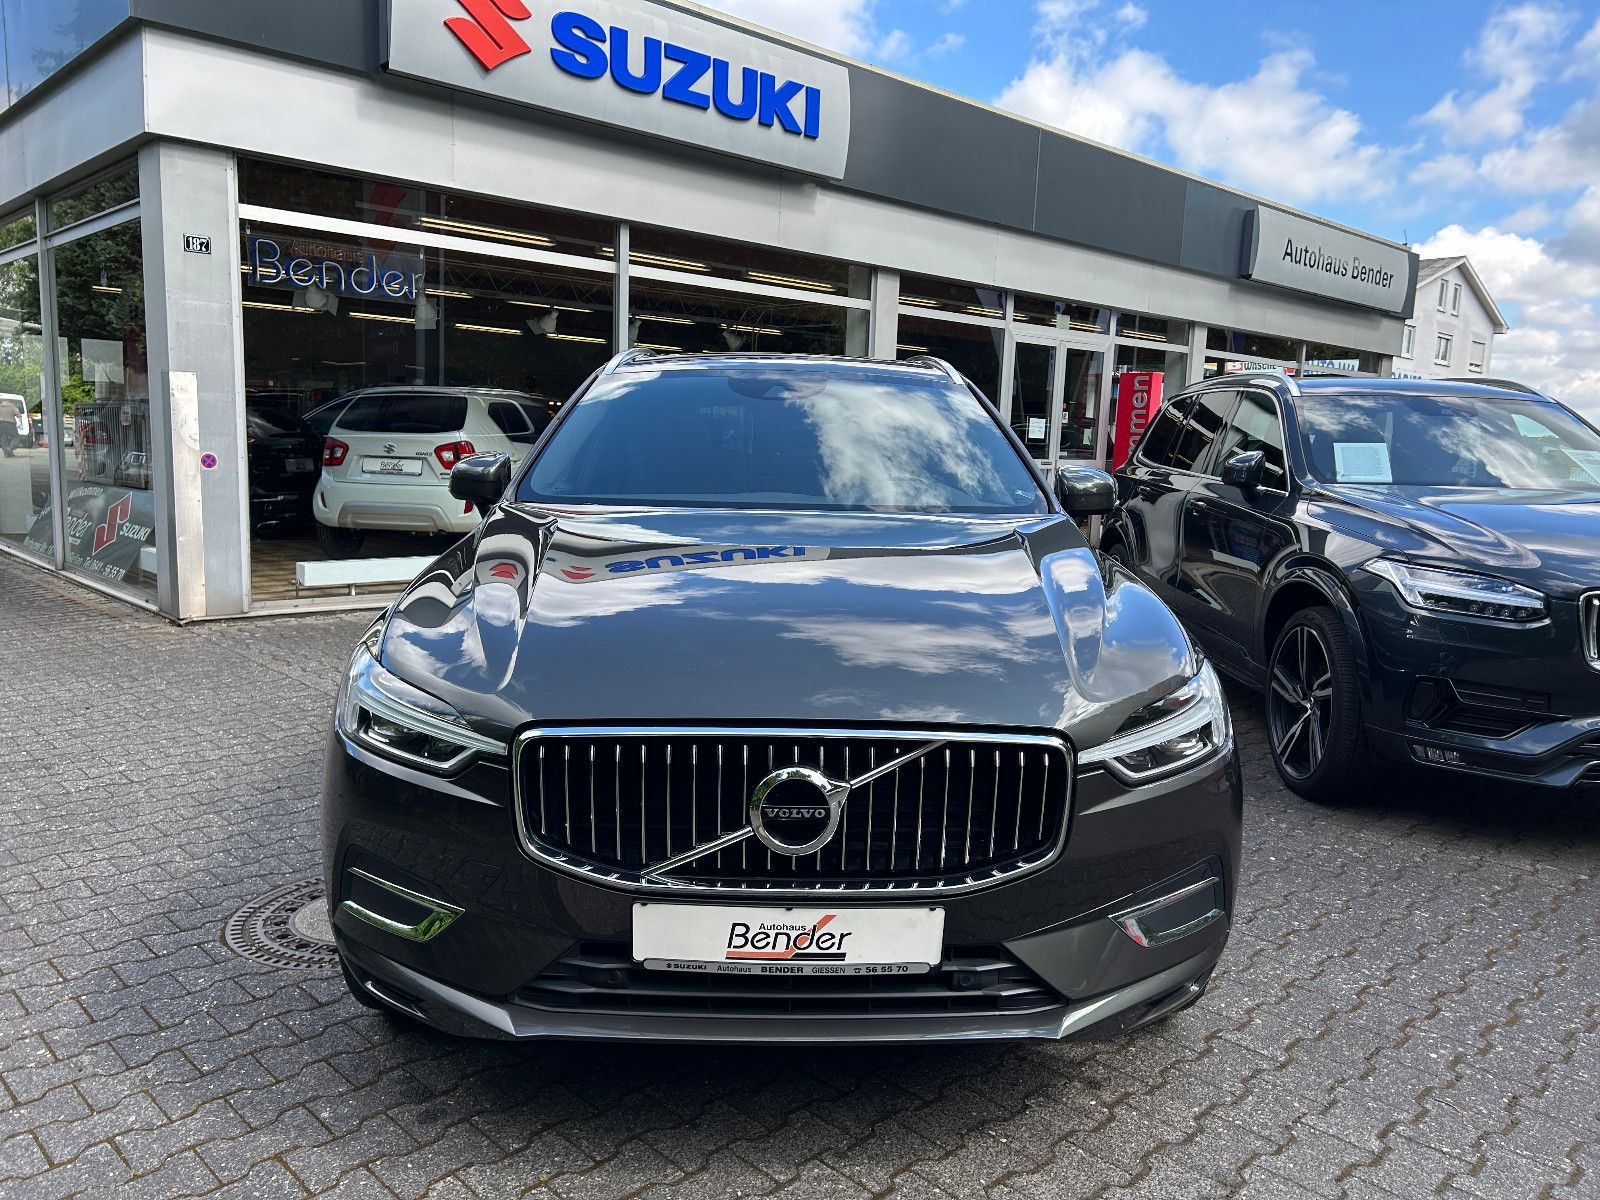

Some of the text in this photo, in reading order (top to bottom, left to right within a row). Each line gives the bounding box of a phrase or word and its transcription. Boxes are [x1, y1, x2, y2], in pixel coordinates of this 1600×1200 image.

[550, 11, 821, 138] SUZUKI
[187, 236, 208, 252] 187
[291, 242, 365, 262] Autohaus
[255, 239, 424, 300] Bender
[1282, 238, 1394, 288] Autohaus Bender
[120, 522, 151, 541] SUZUKI
[764, 808, 826, 818] VOLVO
[727, 922, 852, 951] Bender
[759, 923, 807, 931] Autohaus
[717, 965, 752, 973] Autohaus
[760, 966, 804, 974] BENDER
[811, 966, 846, 974] GIESSEN
